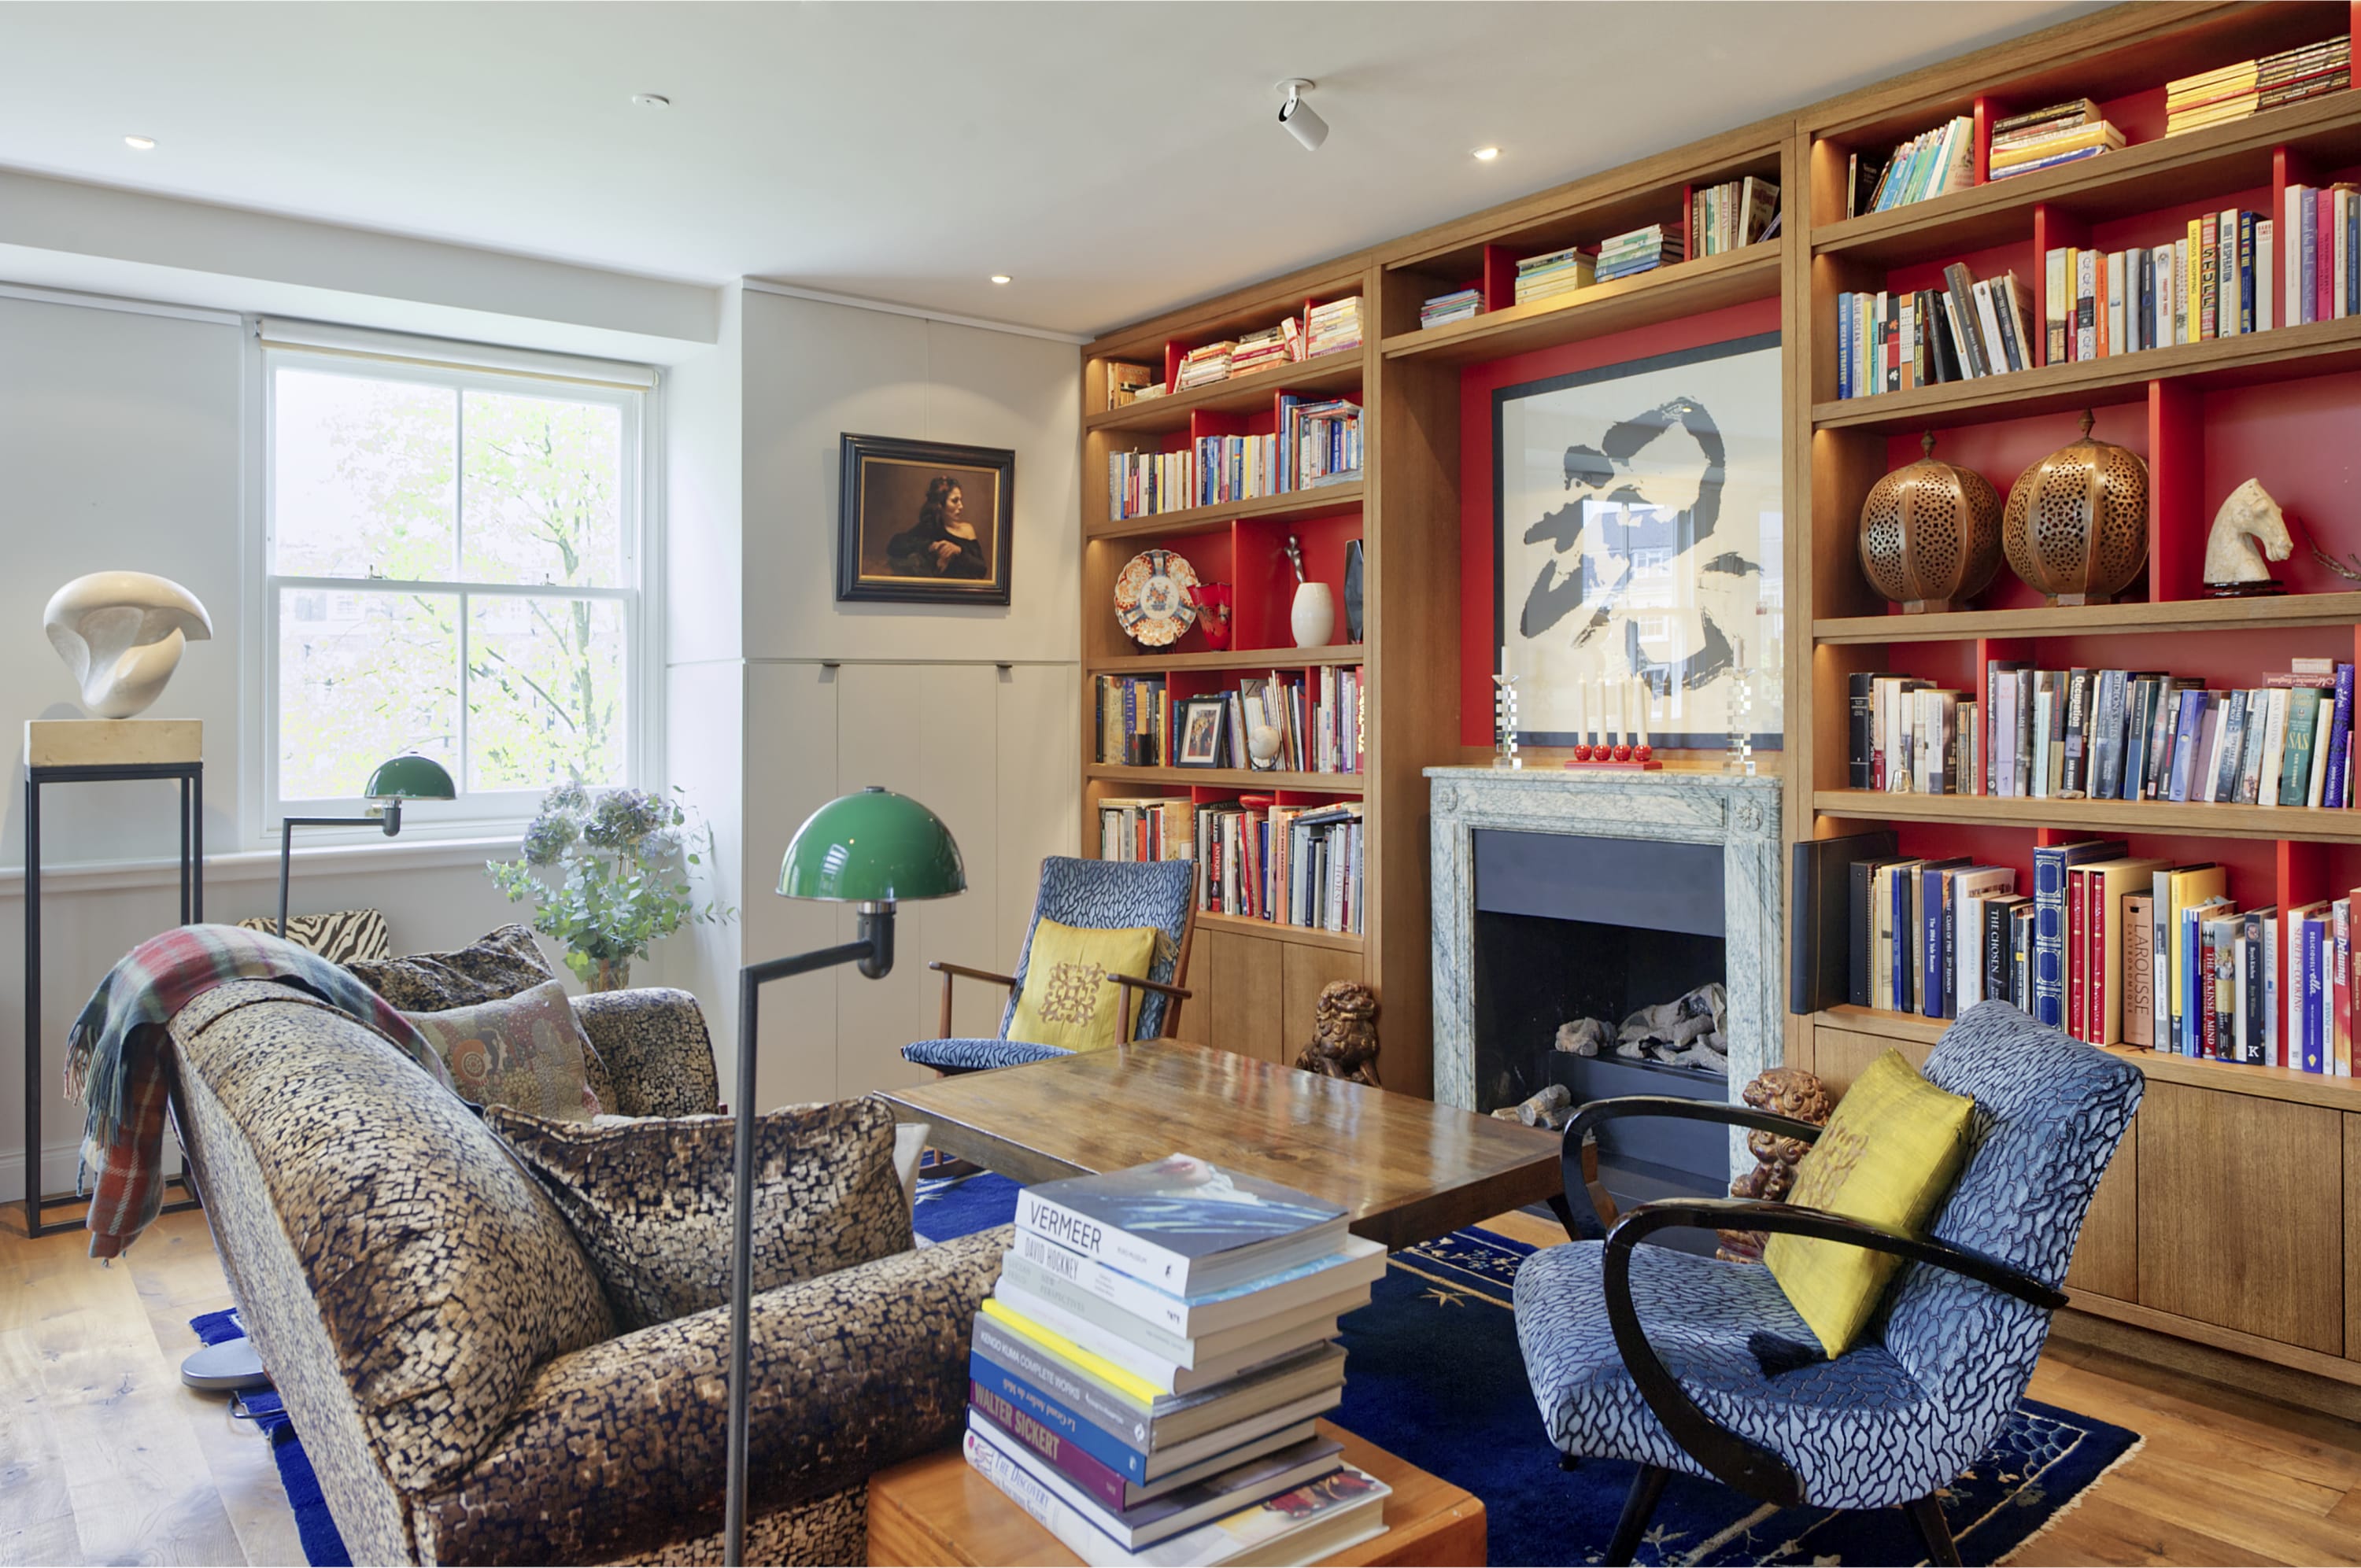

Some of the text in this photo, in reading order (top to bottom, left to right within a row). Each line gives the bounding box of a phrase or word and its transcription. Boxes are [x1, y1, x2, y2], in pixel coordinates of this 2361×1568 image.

[2304, 196, 2314, 226] Paradise
[2222, 242, 2232, 283] DESPERATION
[2304, 246, 2313, 265] Blind
[2202, 246, 2216, 314] STUFF
[2072, 675, 2086, 728] Occupation
[2235, 695, 2244, 721] MICHAEL
[2229, 736, 2237, 759] SPECIAL
[2270, 713, 2280, 749] HASTINGS
[2288, 732, 2309, 751] SAS
[1334, 864, 1343, 907] HORSE
[1990, 909, 2000, 972] THE CHOSEN
[2334, 907, 2348, 986] Sonia Delaunay
[2134, 924, 2149, 1016] LAROUSSE
[2293, 927, 2303, 1013] SECRETS COOKING
[2308, 972, 2321, 995] ella
[2207, 1020, 2215, 1045] MIND
[1031, 1201, 1102, 1253] VERMEER
[1025, 1237, 1079, 1282] DAVID HOCKNEY
[1040, 1285, 1085, 1312] PERSPECTIVES
[1166, 1310, 1180, 1325] TATE
[981, 1330, 1081, 1401] KENGO KUMA COMPLETE WORKS
[974, 1382, 1060, 1461] WALTER SICKERT
[1046, 1404, 1066, 1426] Grand
[1067, 1419, 1076, 1433] Le
[995, 1452, 1050, 1508] THE DISCOVERY
